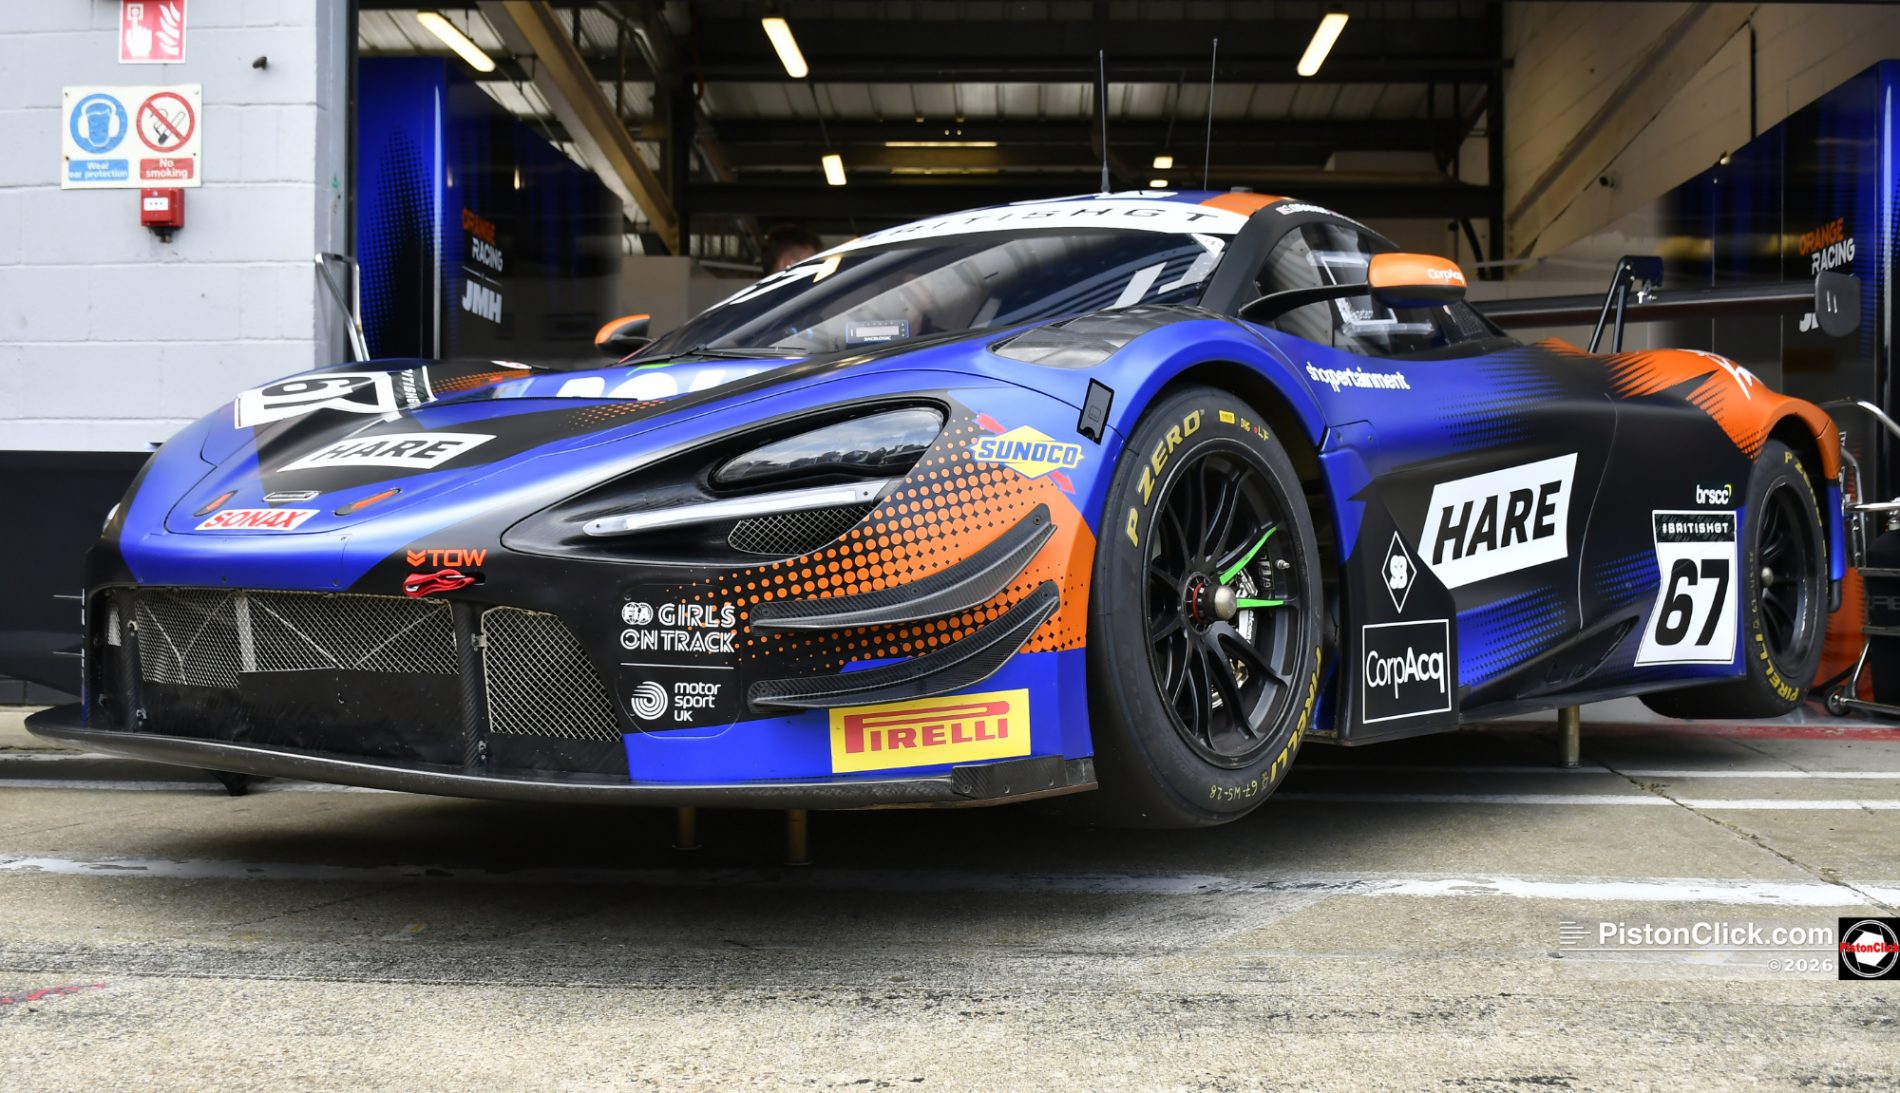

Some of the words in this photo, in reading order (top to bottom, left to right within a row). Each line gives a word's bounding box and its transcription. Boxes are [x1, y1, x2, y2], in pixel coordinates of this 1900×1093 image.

[85, 169, 128, 179] protection
[87, 161, 109, 170] Wear
[146, 167, 188, 178] smoking
[160, 158, 174, 168] No
[1800, 216, 1844, 256] ORANGE
[472, 236, 504, 272] RACING
[1812, 238, 1855, 275] RACING
[462, 279, 502, 324] JMH
[311, 440, 465, 461] HARE
[975, 436, 1080, 464] SUNOCO
[1136, 409, 1203, 507] ZERO
[1696, 484, 1730, 505] brscc
[203, 510, 308, 529] SONAX
[1432, 480, 1562, 566] HARE
[1662, 522, 1730, 535] #BRITISHGT
[426, 548, 487, 568] TOW
[1655, 558, 1730, 646] 67
[623, 603, 653, 624] FIA
[658, 603, 736, 628] GIRLS
[620, 628, 658, 650] ON
[660, 630, 736, 653] TRACK
[1366, 647, 1446, 700] CorpAcq
[1736, 633, 1800, 703] PIRELLI
[674, 682, 721, 695] motor
[674, 695, 716, 709] sport
[674, 709, 694, 722] UK
[844, 700, 1010, 753] PIRELLI
